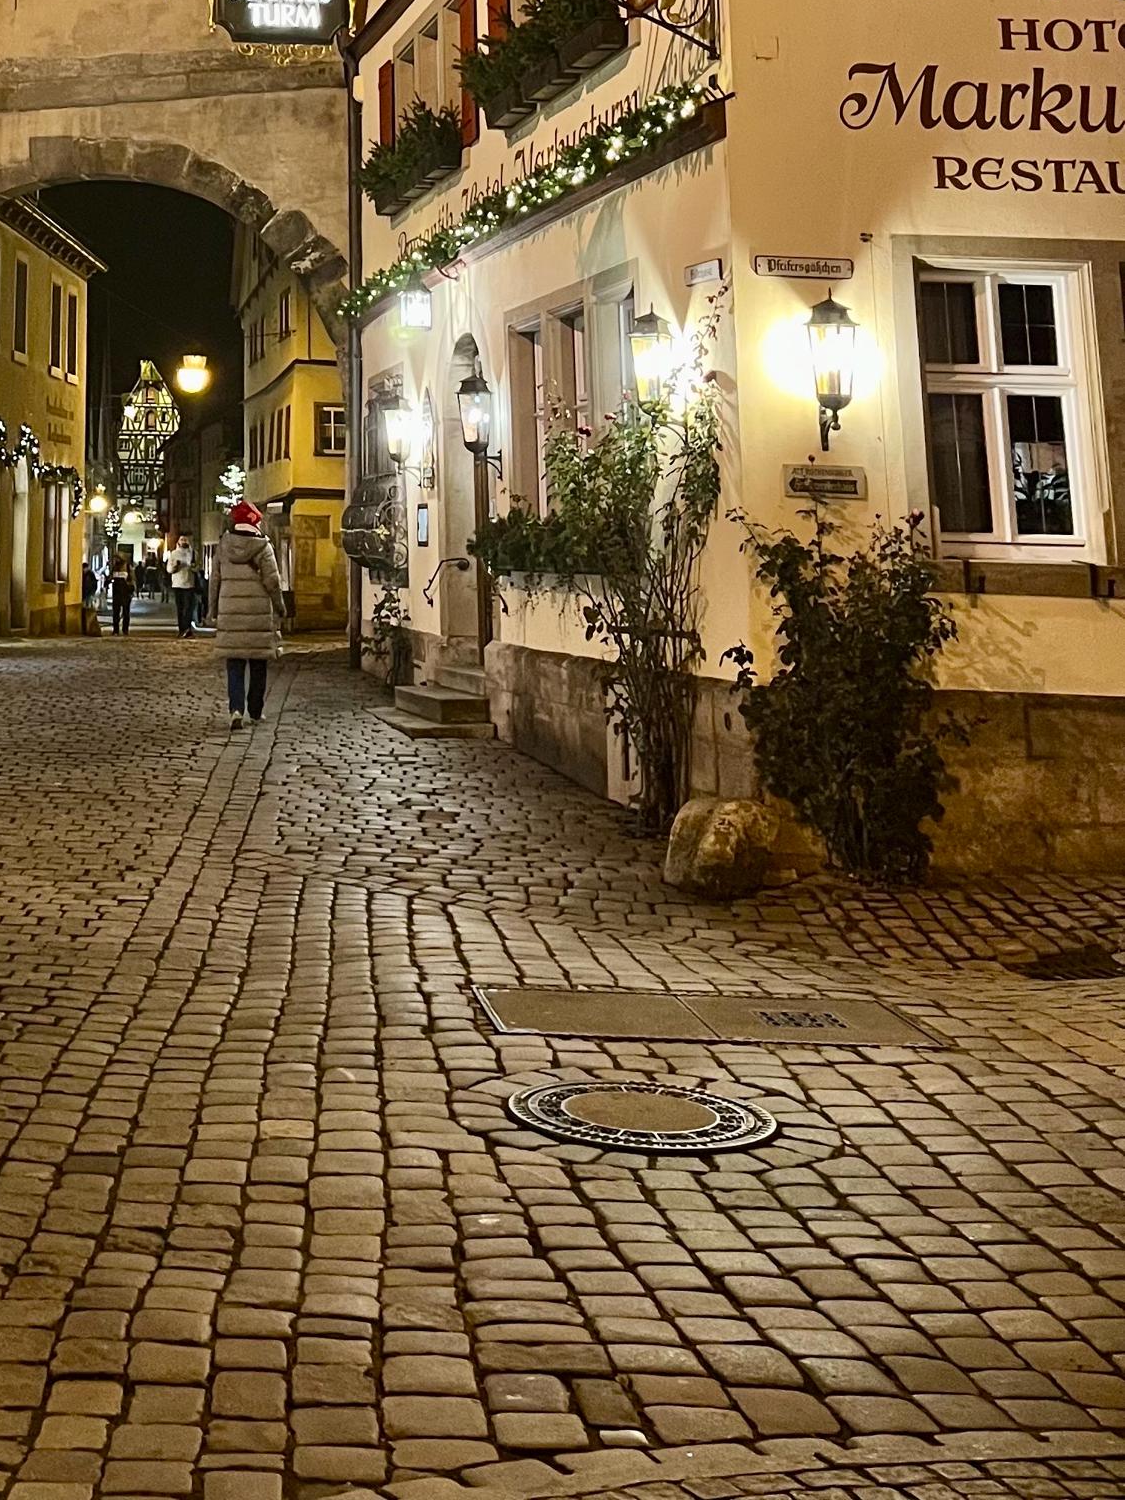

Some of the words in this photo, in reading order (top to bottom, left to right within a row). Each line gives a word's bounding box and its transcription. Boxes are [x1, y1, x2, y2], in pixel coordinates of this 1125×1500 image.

[248, 2, 321, 29] TURM
[997, 17, 1125, 53] HOT
[839, 61, 1125, 134] Marku
